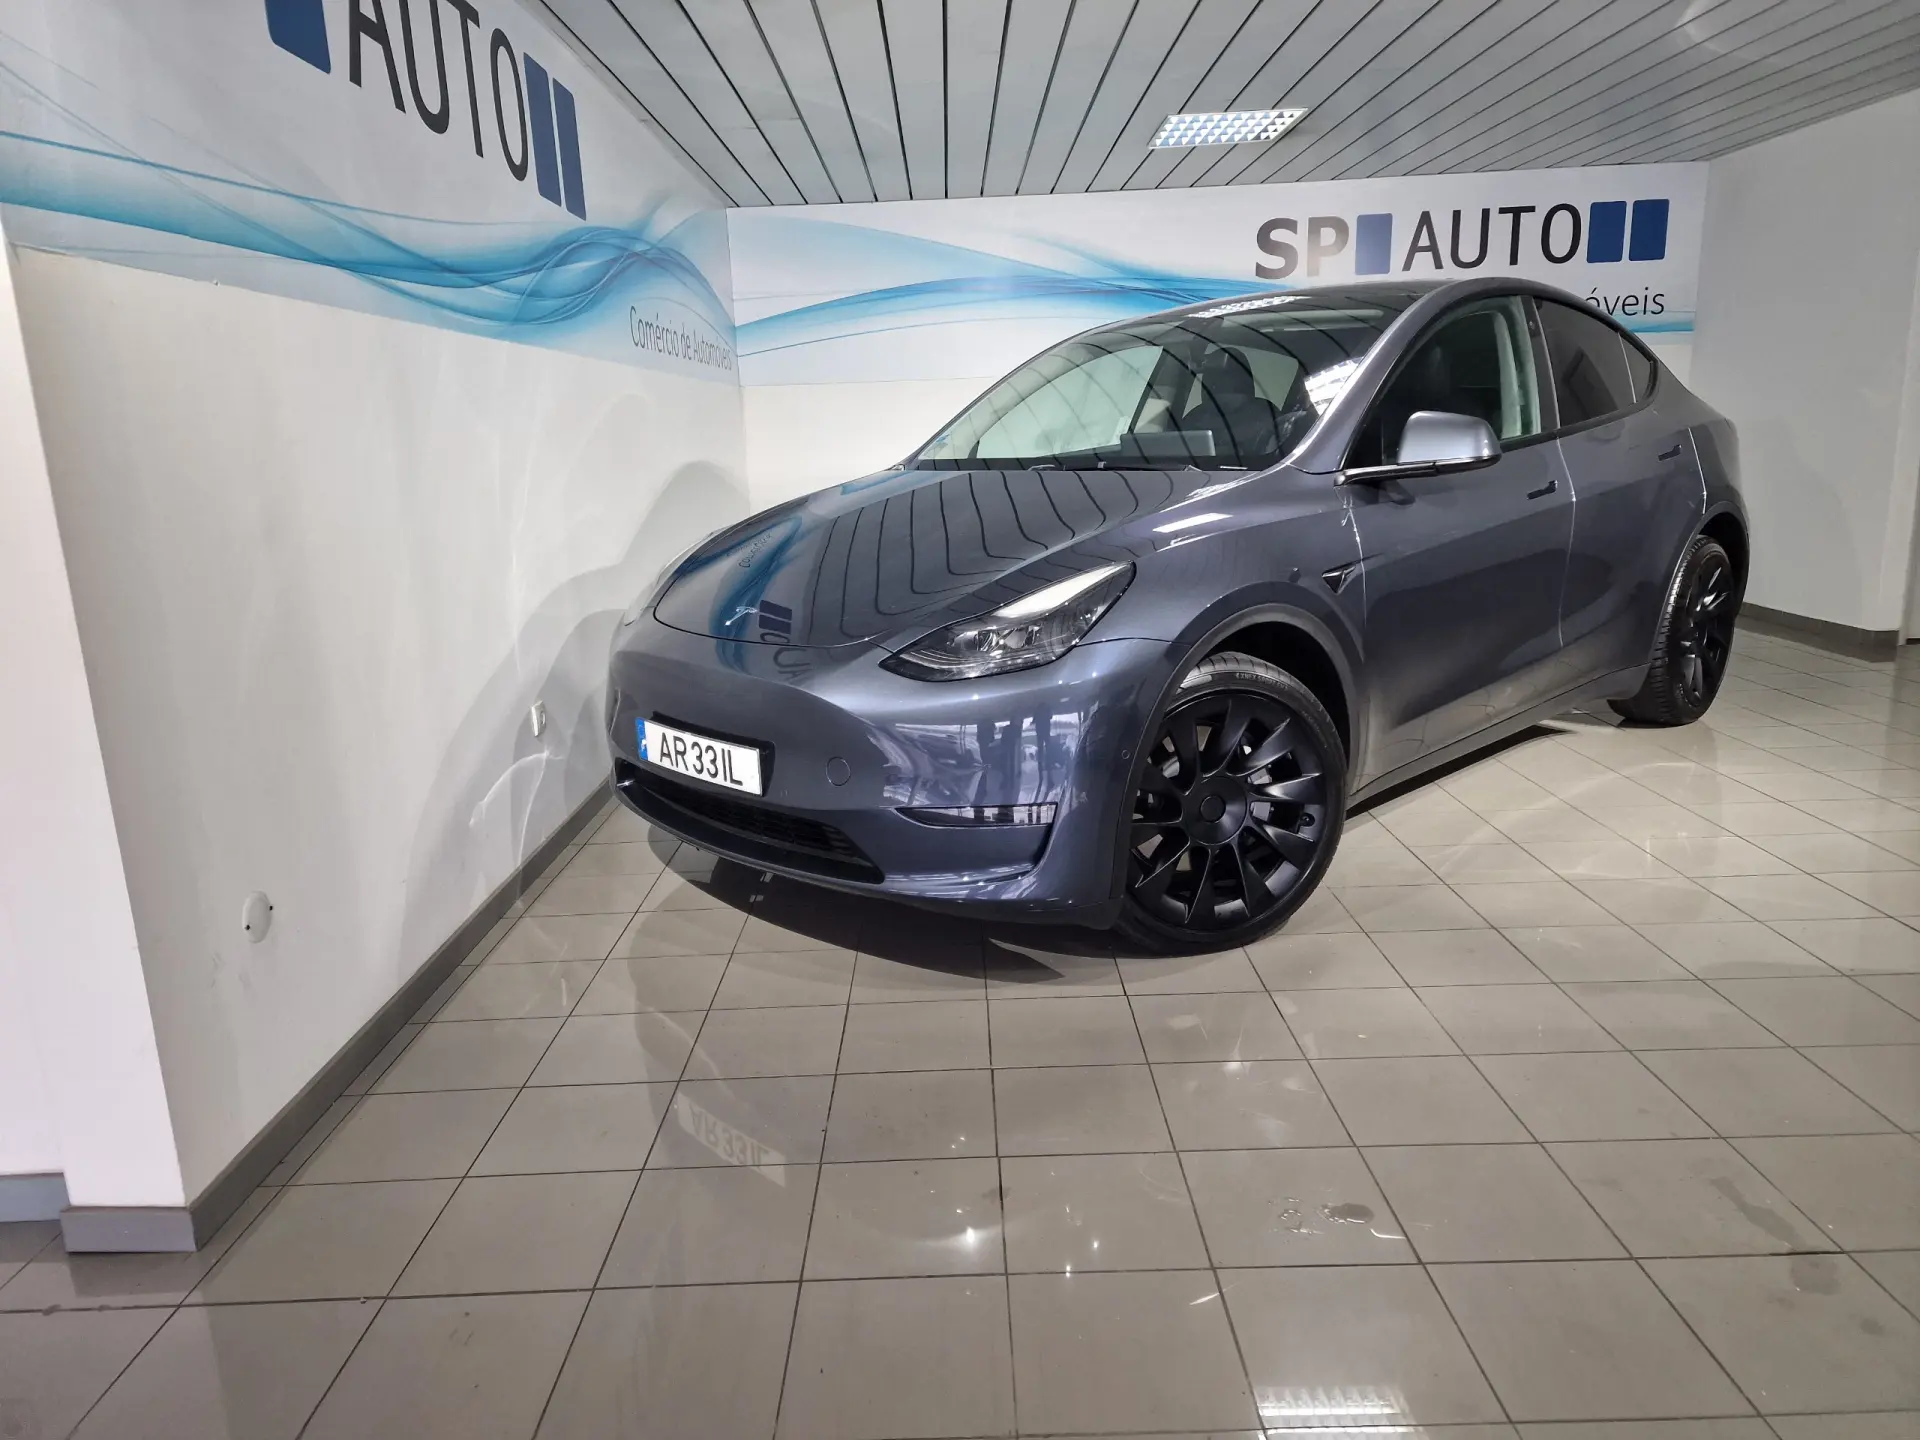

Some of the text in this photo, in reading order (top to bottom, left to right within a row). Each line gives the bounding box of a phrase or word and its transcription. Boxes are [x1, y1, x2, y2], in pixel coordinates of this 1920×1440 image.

[1255, 203, 1582, 280] SP AUTO
[630, 305, 732, 370] Comércio de Automóveis
